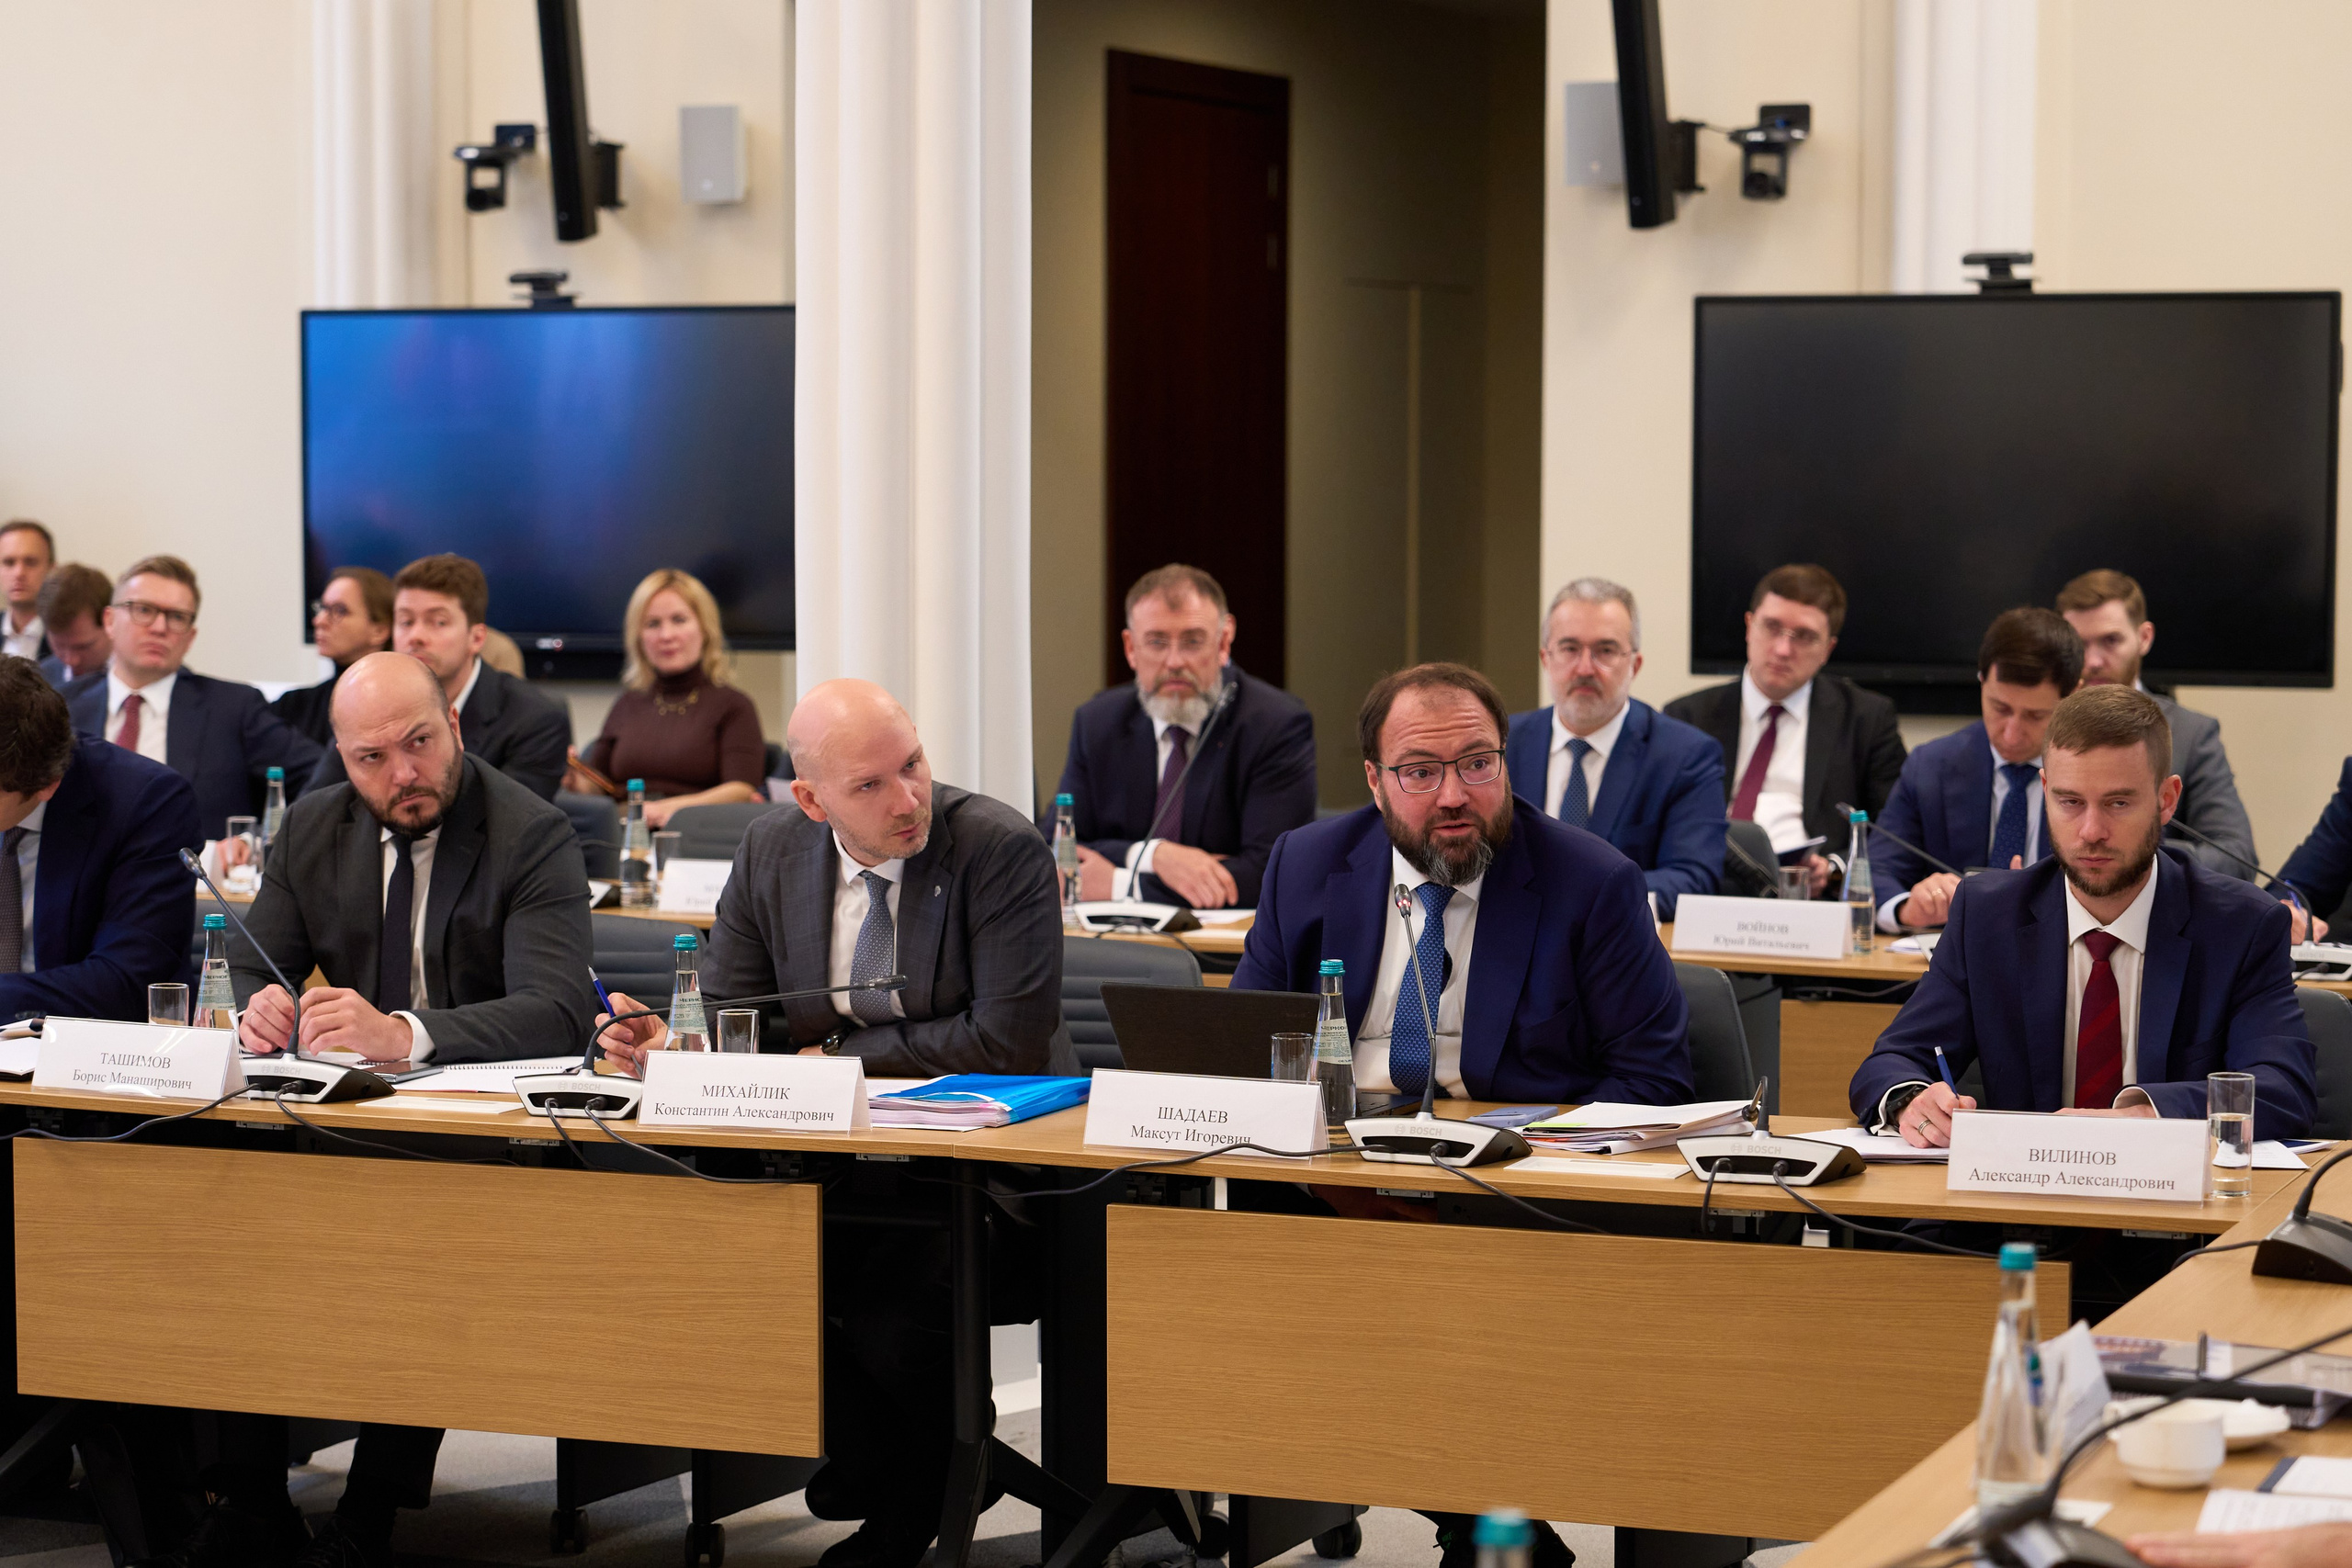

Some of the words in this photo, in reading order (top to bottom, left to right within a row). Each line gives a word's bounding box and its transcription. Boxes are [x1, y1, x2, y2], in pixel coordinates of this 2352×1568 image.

[1736, 920, 1789, 934] ВОЙНОВ
[1713, 934, 1745, 947] Юрий
[1747, 935, 1810, 951] Витальевич
[100, 1052, 171, 1069] ТАШИМОВ
[73, 1068, 107, 1085] Борис
[109, 1072, 192, 1090] Манаширович
[274, 1066, 301, 1076] BOSCH
[571, 1082, 601, 1091] BOSCH
[702, 1083, 791, 1100] МИХАЙЛИК
[654, 1102, 729, 1118] Константин
[732, 1105, 834, 1123] Александрович
[1158, 1106, 1228, 1124] ШАДАЕВ
[1131, 1124, 1182, 1143] Максут
[1184, 1128, 1251, 1146] Игоревич
[1409, 1126, 1442, 1137] BOSCH
[1747, 1145, 1781, 1155] BOSCH
[2029, 1148, 2117, 1166] ВИЛИНОВ
[1969, 1168, 2050, 1187] Александр
[2054, 1171, 2176, 1191] Александрович
